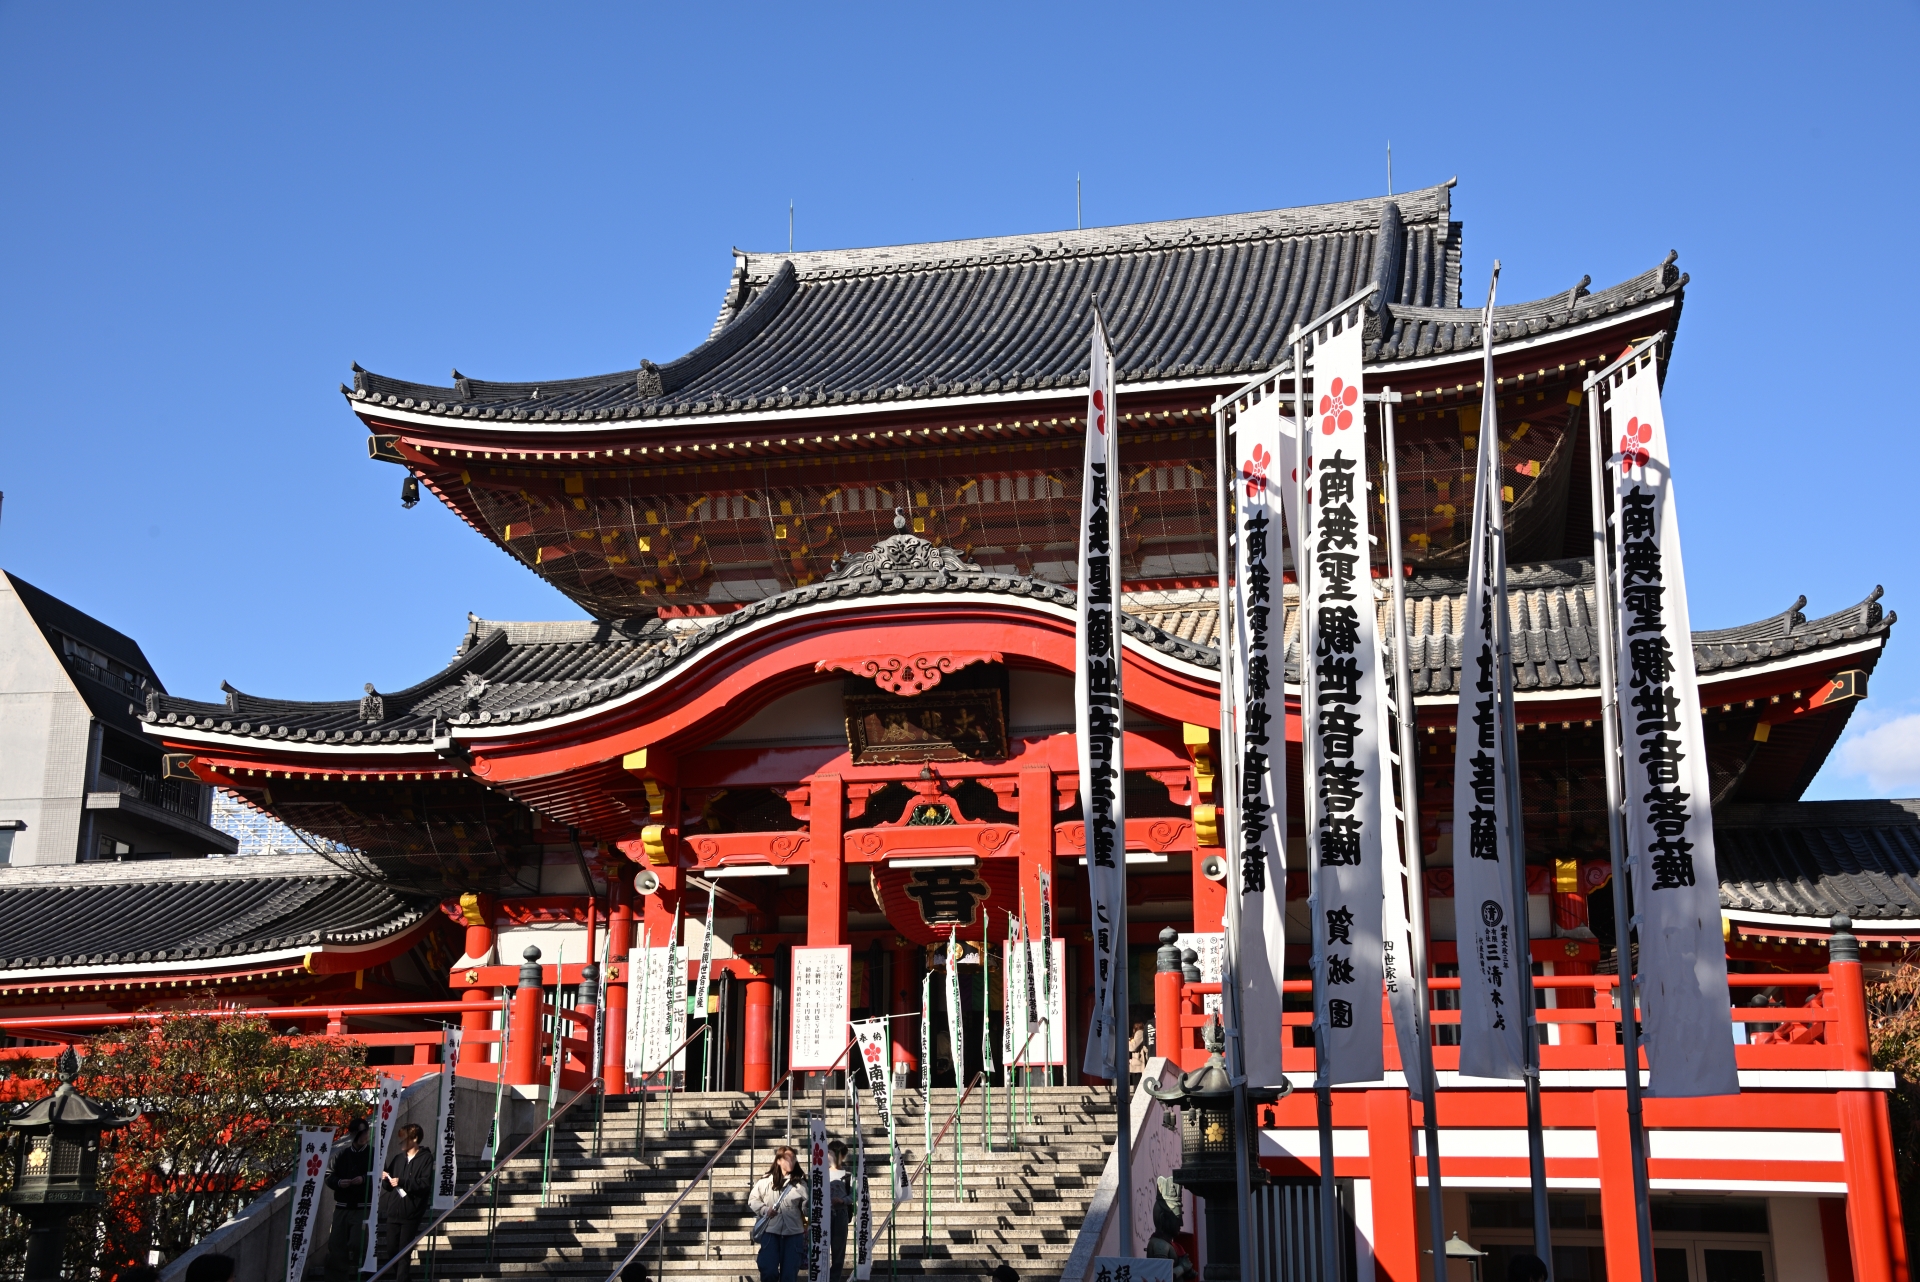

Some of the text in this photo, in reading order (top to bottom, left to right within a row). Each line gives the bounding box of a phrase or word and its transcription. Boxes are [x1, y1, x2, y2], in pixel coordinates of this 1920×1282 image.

[1383, 940, 1399, 993] 四世家元
[859, 1032, 882, 1044] 奉納
